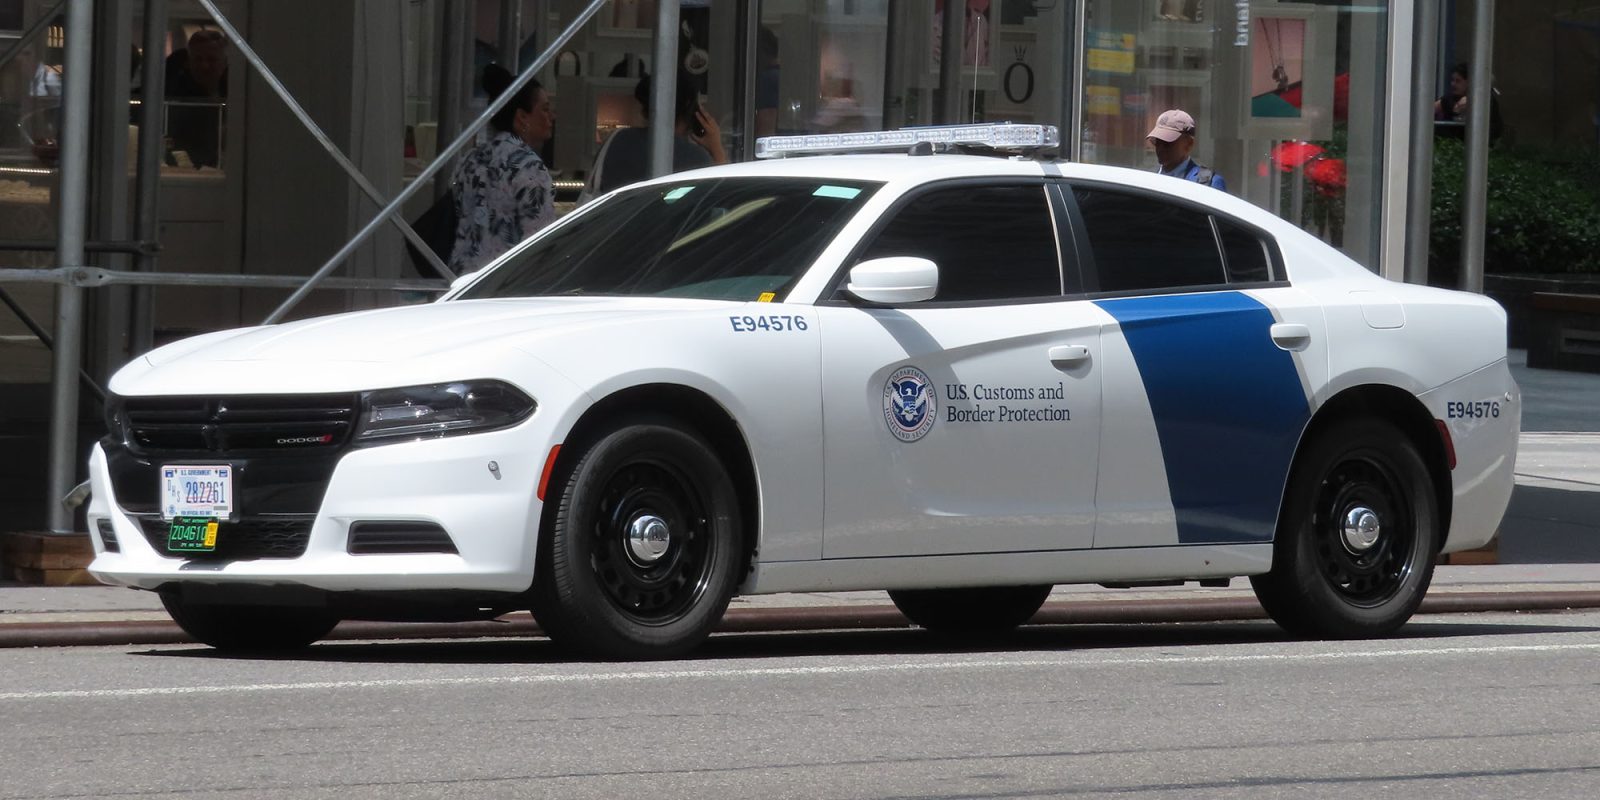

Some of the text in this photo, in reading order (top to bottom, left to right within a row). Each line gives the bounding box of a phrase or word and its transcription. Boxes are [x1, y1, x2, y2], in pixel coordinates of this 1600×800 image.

[729, 315, 808, 332] E94576
[946, 382, 1064, 400] U.S. Customs and
[947, 404, 1071, 422] Border Protection
[1447, 401, 1500, 418] E94576
[186, 481, 226, 504] 282261
